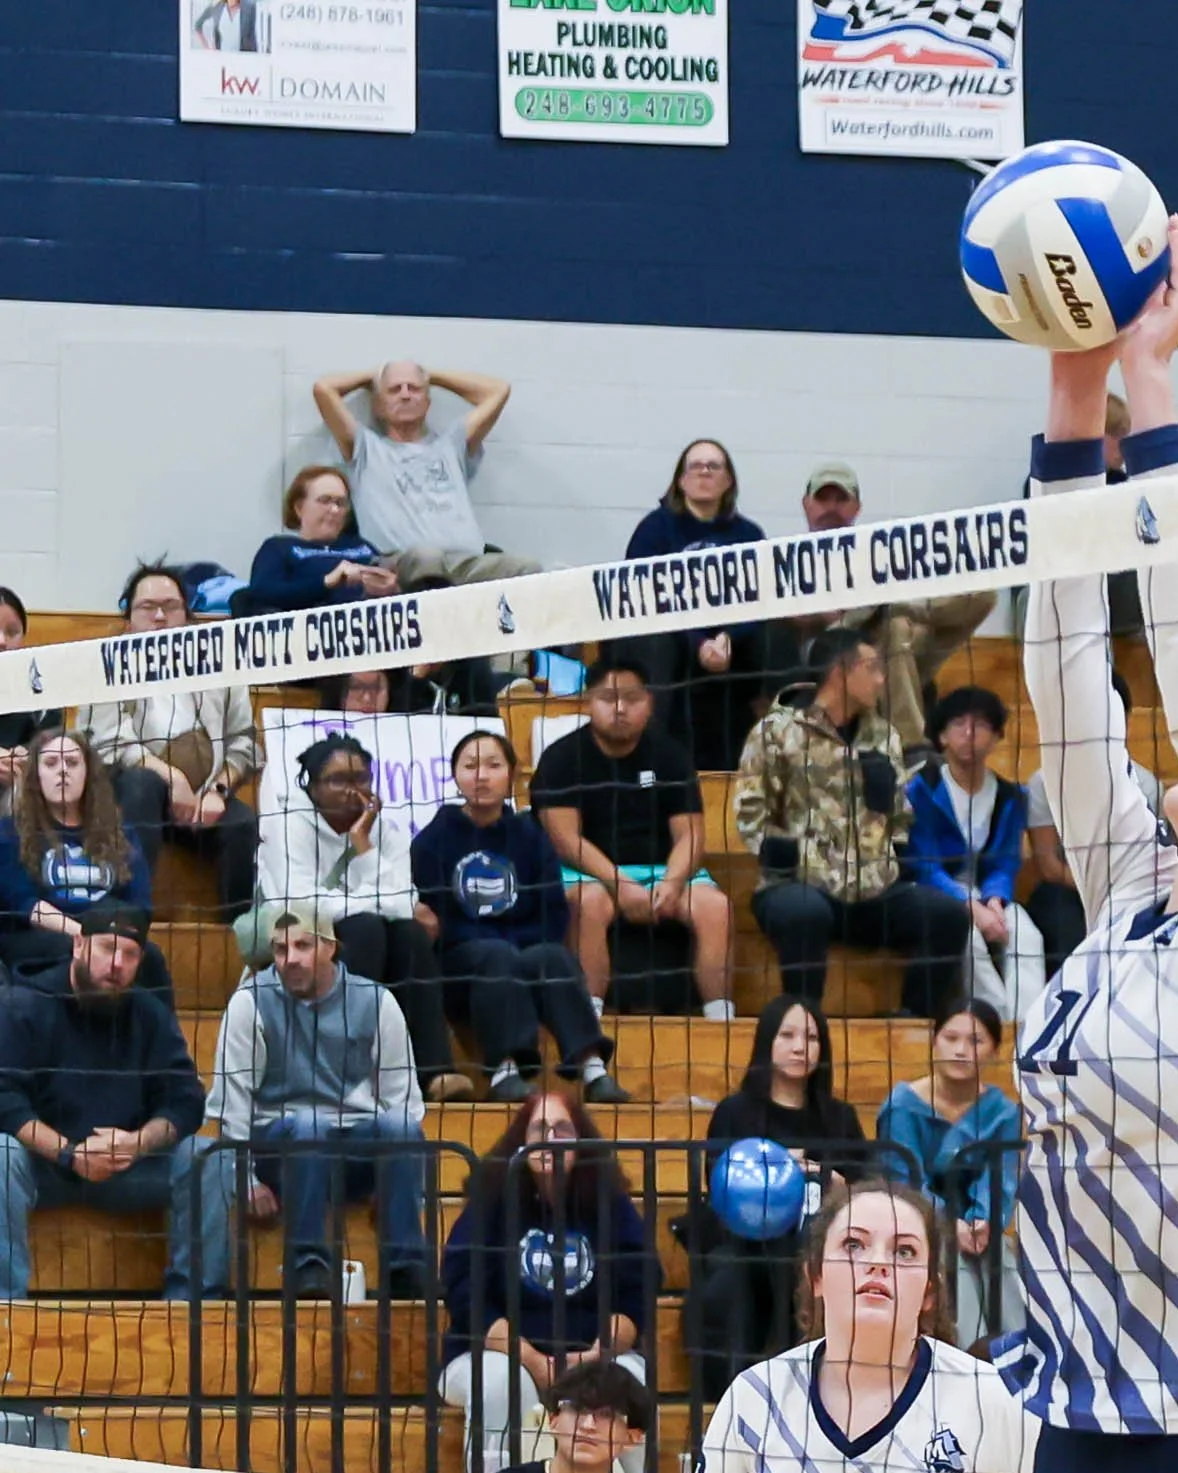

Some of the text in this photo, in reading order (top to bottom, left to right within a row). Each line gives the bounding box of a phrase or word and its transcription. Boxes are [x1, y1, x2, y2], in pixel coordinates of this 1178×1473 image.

[557, 22, 668, 49] PLUMBING
[508, 52, 719, 82] HEATING & COOLING
[802, 65, 1017, 97] WATERFORD HILLS
[281, 78, 386, 102] DOMAIN
[525, 91, 706, 120] 248-693-4775
[832, 119, 994, 141] Waterfordhills.com
[1044, 253, 1094, 329] Baden
[592, 507, 1029, 622] WATERFORD MOTT CORSAIRS
[101, 600, 423, 687] WATERFORD MOTT CORSAIRS
